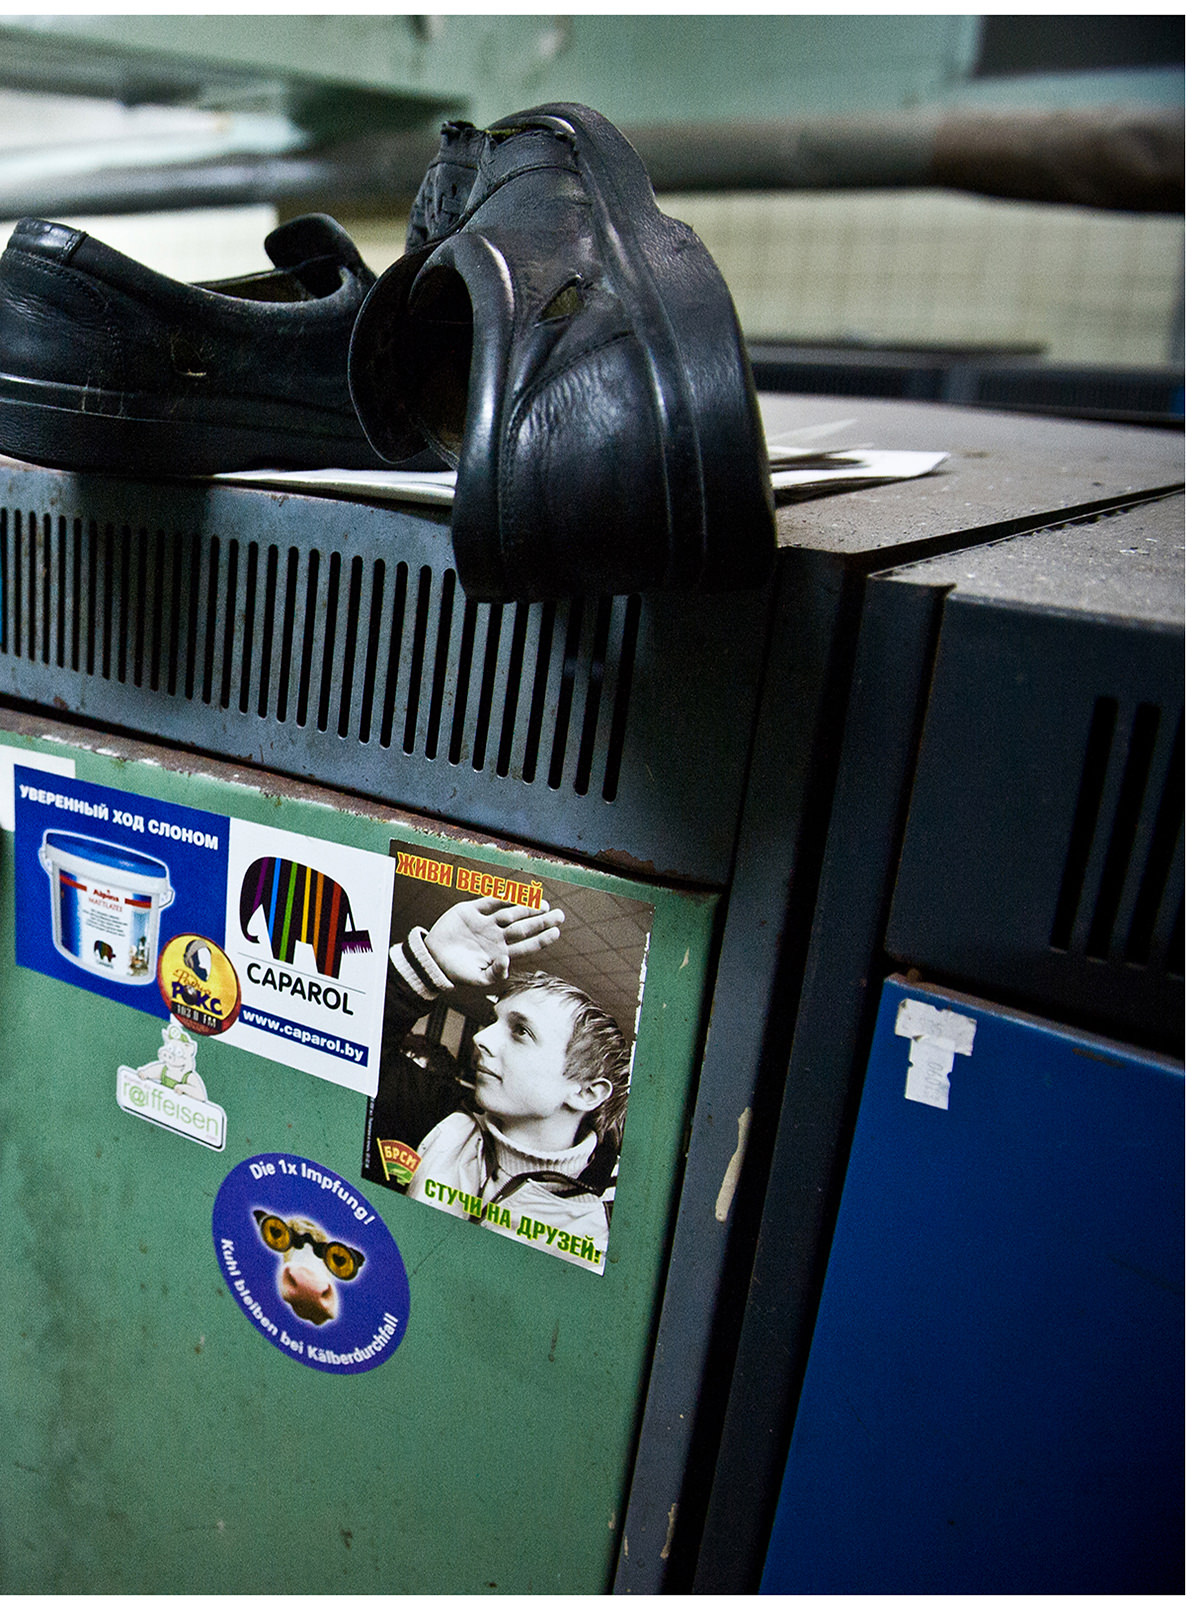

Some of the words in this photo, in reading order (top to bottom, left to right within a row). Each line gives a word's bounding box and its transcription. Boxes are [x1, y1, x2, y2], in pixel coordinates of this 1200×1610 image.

[18, 784, 110, 822] УВЕРЕННЫЙ
[112, 809, 146, 833] ХОД
[147, 819, 220, 851] СЛОНОМ
[395, 851, 454, 888] ЖИВИ
[456, 866, 544, 911] ВЕСЕЛЕЙ
[246, 962, 355, 1016] CAPAROL
[242, 1009, 365, 1063] www.caparol.by
[383, 1145, 418, 1171] БРСМ
[249, 1161, 276, 1180] Die
[278, 1159, 299, 1177] 1x
[300, 1162, 377, 1226] Impfung!
[424, 1178, 484, 1218] СТУЧИ
[486, 1202, 512, 1230] НА
[516, 1215, 603, 1265] ДРУЗЕЙ!
[233, 1279, 279, 1336] bleiben
[279, 1331, 304, 1354] bei
[306, 1312, 400, 1366] Kälberdurchfall
